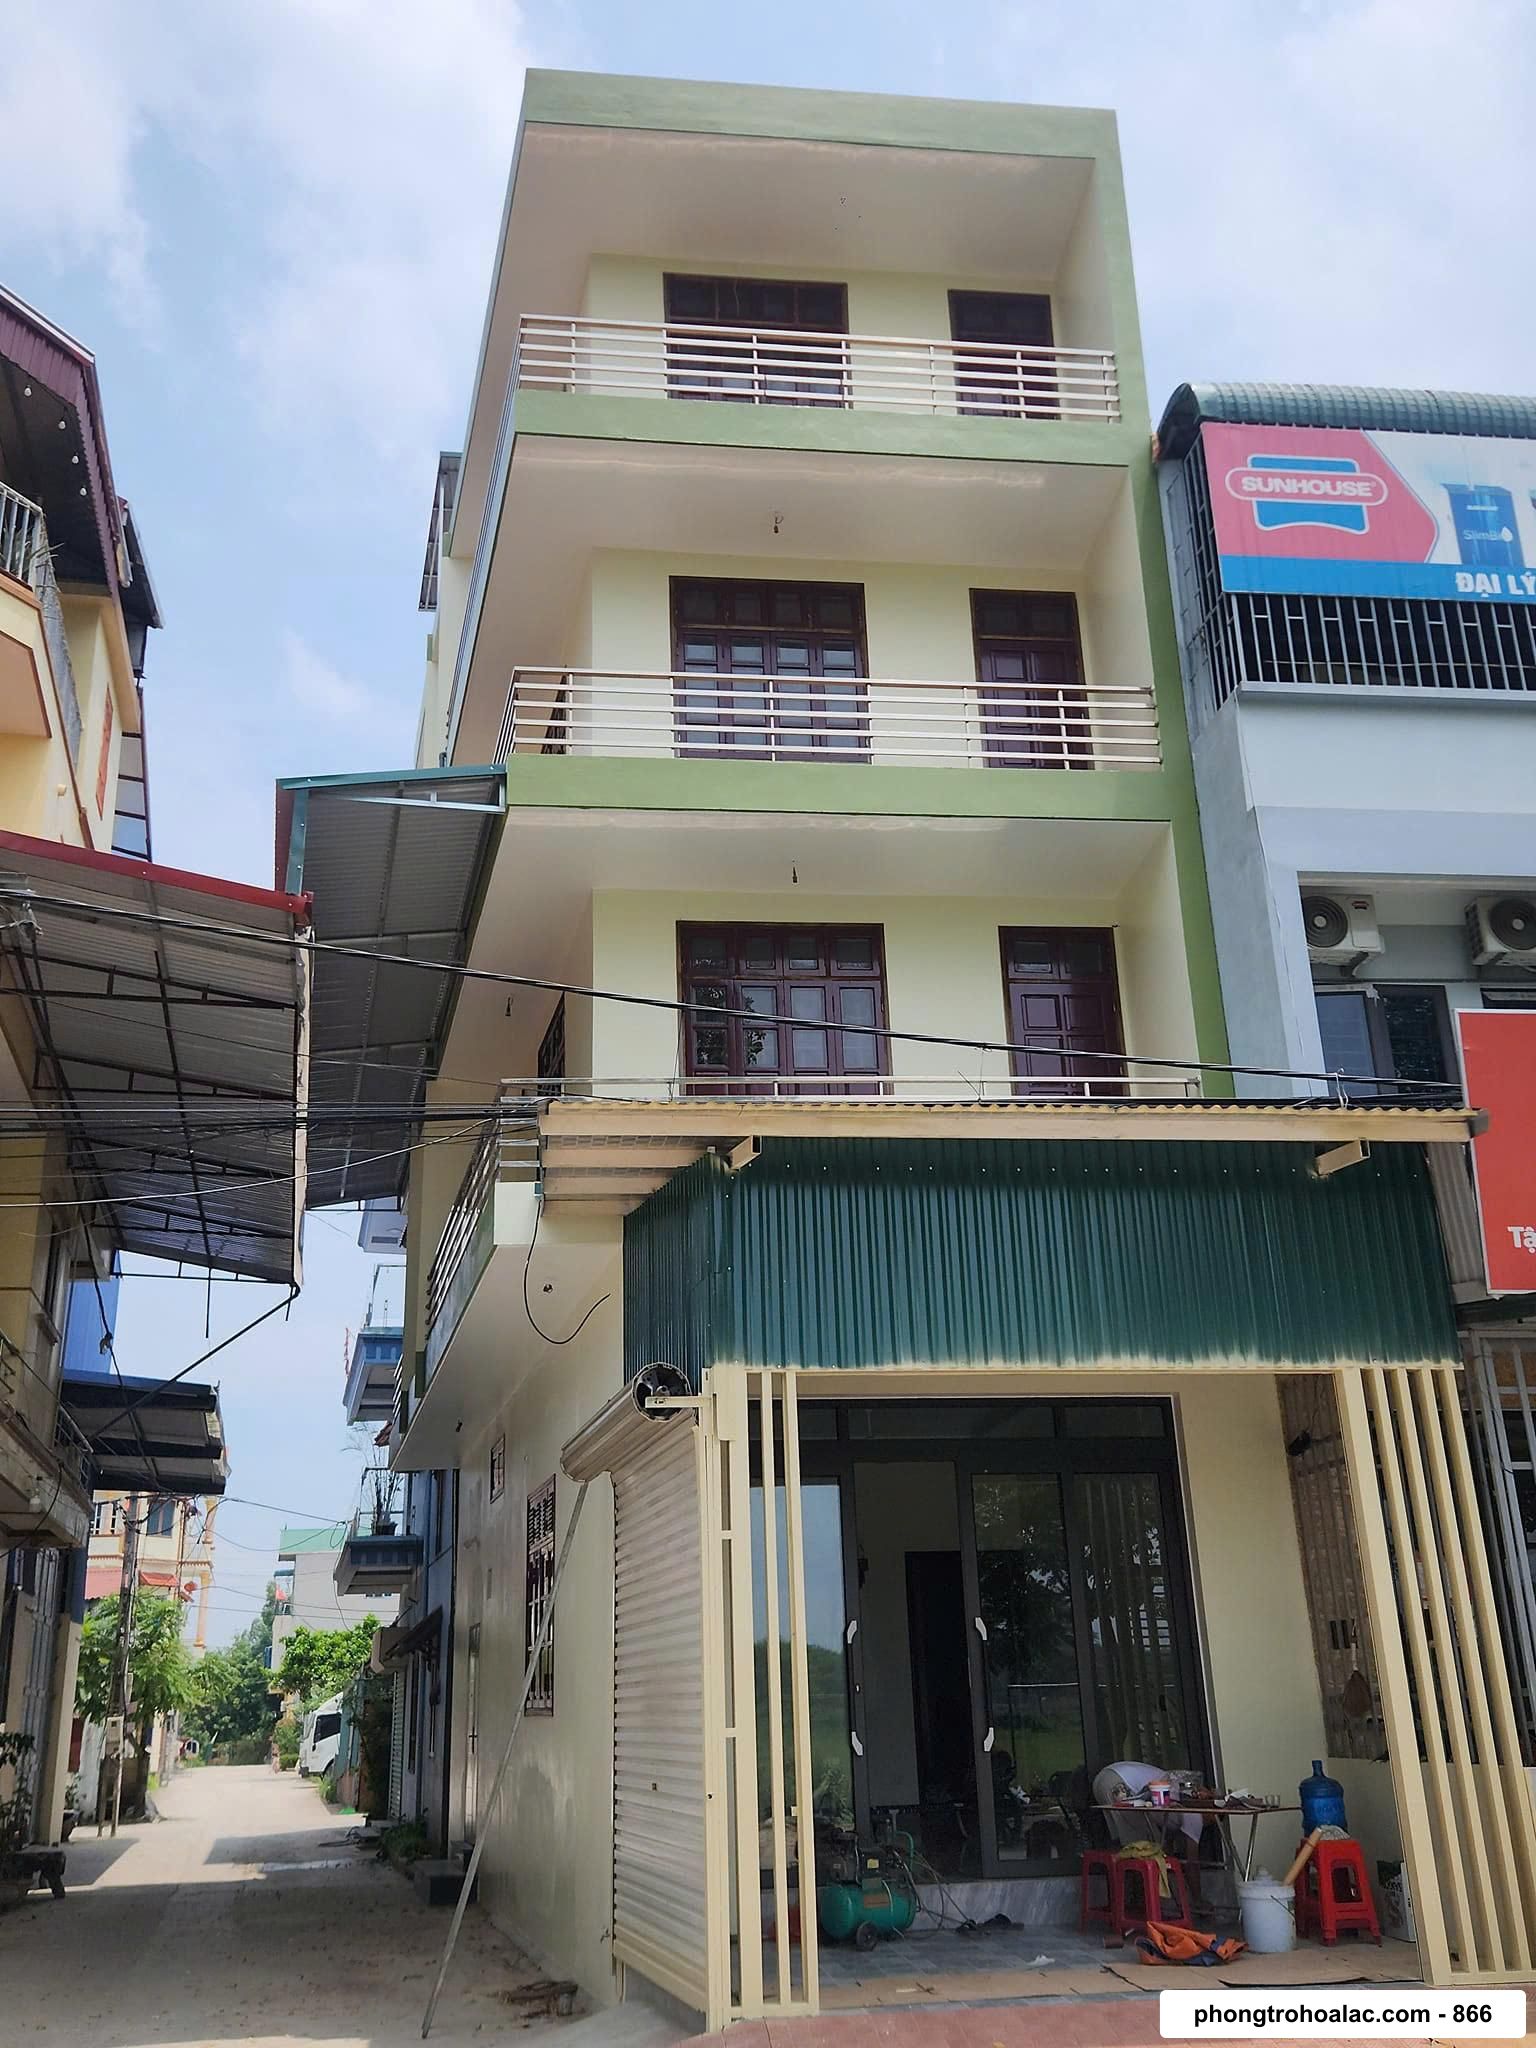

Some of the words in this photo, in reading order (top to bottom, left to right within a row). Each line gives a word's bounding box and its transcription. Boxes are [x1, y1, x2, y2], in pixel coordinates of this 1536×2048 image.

[1242, 476, 1373, 497] SUNHOUSE
[1456, 572, 1502, 597] ĐẠI
[1507, 571, 1536, 595] LÝ
